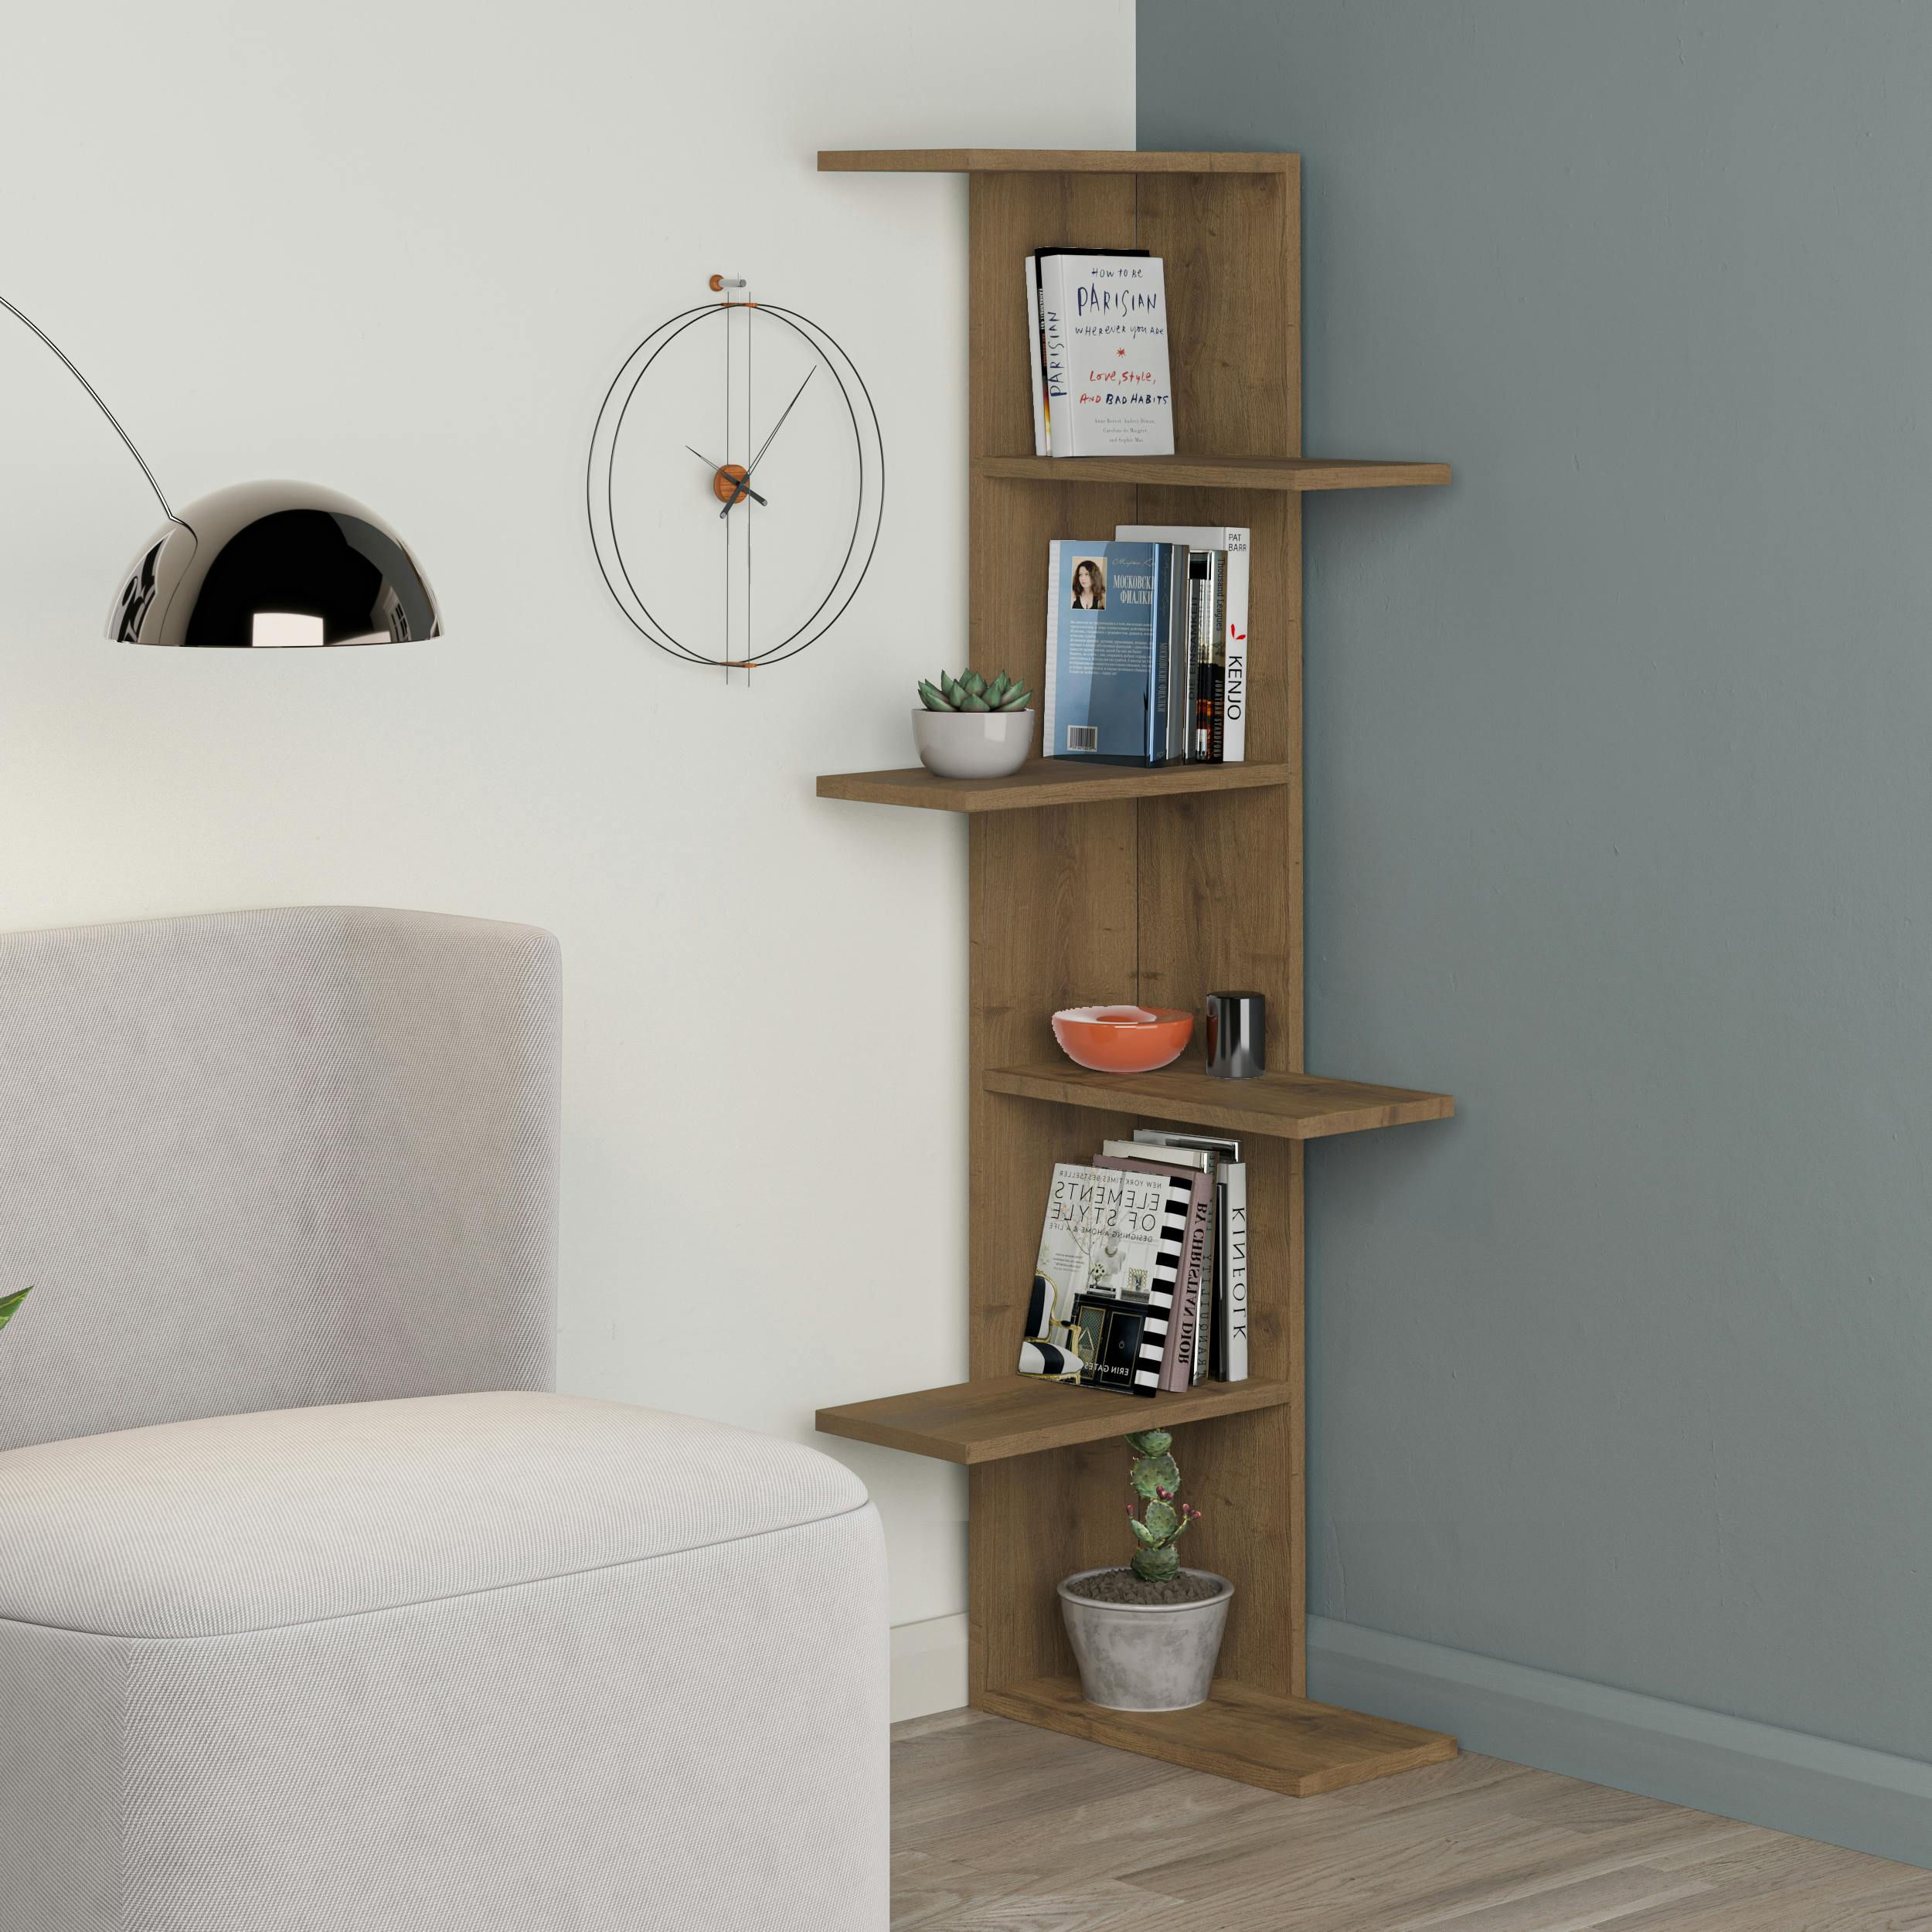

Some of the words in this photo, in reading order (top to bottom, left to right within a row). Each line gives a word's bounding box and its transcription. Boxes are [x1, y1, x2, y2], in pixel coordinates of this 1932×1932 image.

[1077, 282, 1157, 317] PARISIAN
[1048, 311, 1067, 397] PARISIAN
[1080, 393, 1101, 404] AND
[1106, 393, 1127, 405] BAD
[1228, 543, 1247, 552] BARR
[1229, 533, 1242, 542] PAT
[1217, 558, 1226, 598] Thousand
[1121, 590, 1153, 604] ФИАЛКИ
[1215, 599, 1224, 631] Leagues
[1214, 679, 1223, 715] JONATHAN
[1227, 655, 1243, 720] KENJO
